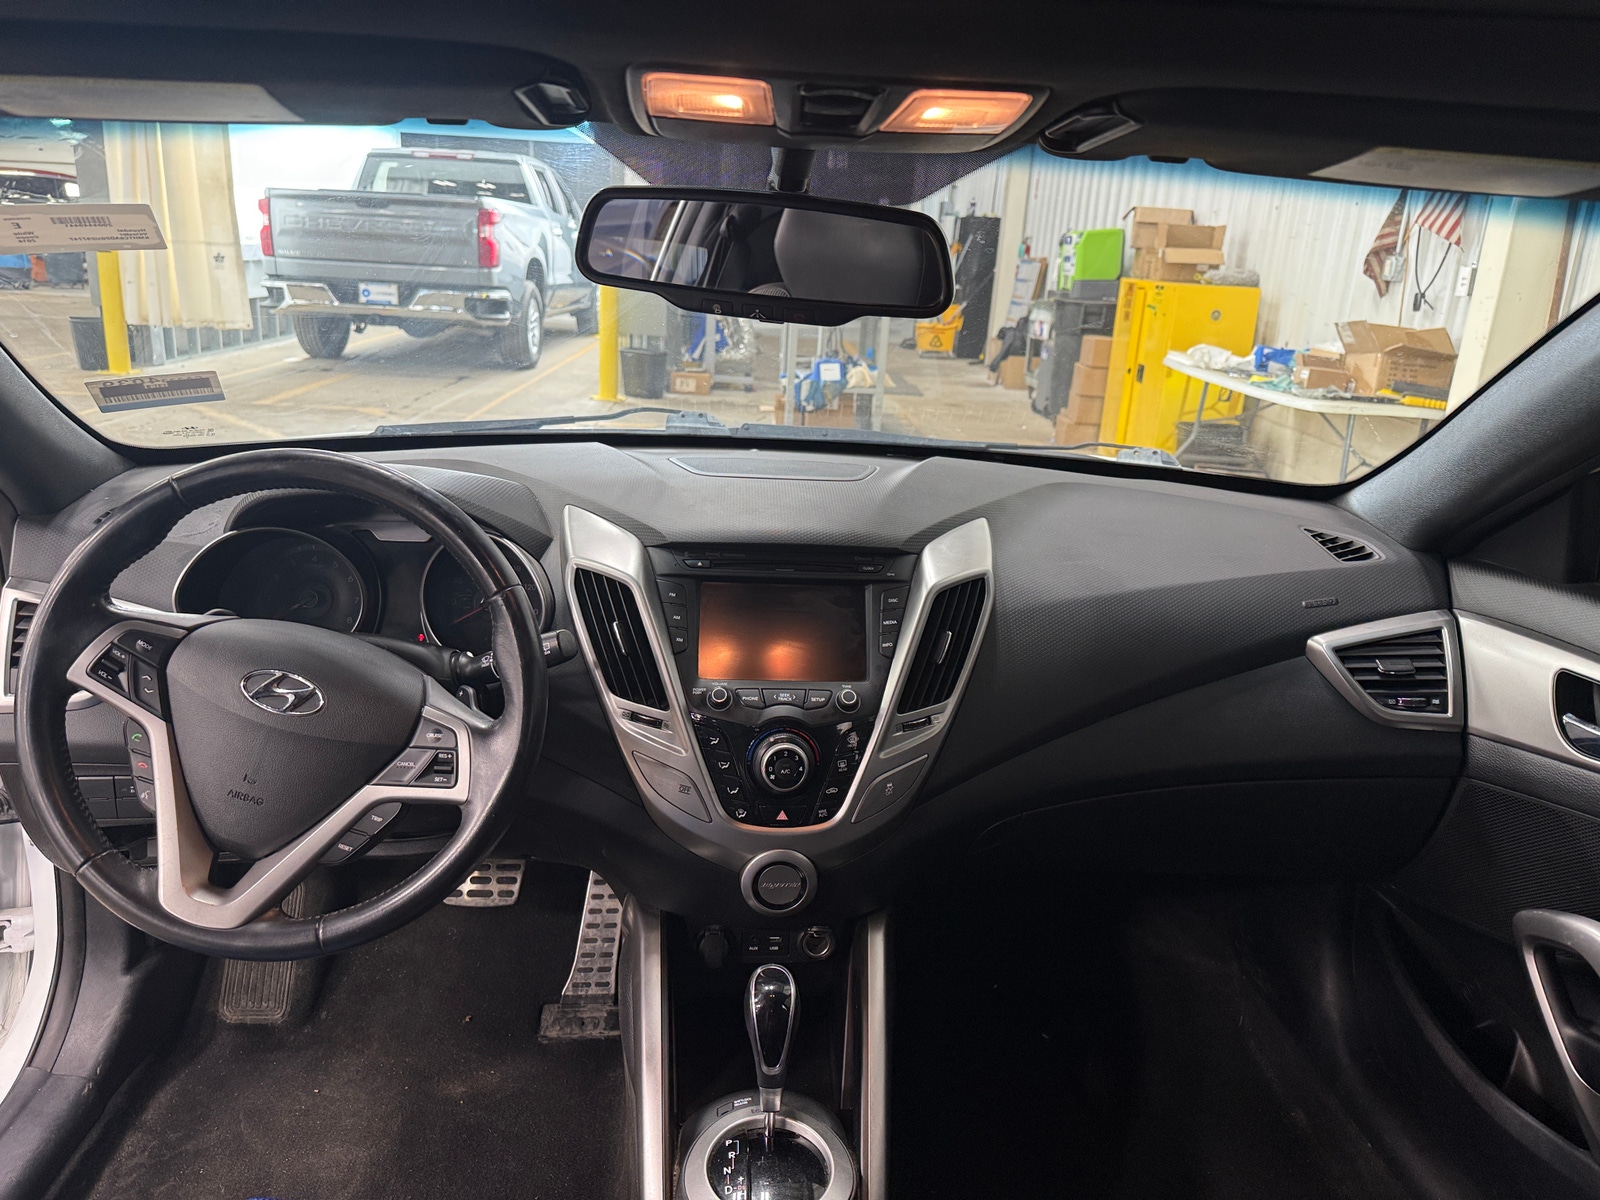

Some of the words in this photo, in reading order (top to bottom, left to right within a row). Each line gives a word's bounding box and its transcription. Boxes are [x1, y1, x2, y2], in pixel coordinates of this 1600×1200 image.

[136, 639, 153, 651] MODE
[226, 789, 264, 806] AIRBAG
[371, 814, 384, 822] TRIP
[338, 843, 353, 852] RESET
[725, 1139, 733, 1147] P
[728, 1151, 736, 1159] R
[723, 1166, 732, 1175] N
[724, 1185, 733, 1195] D
